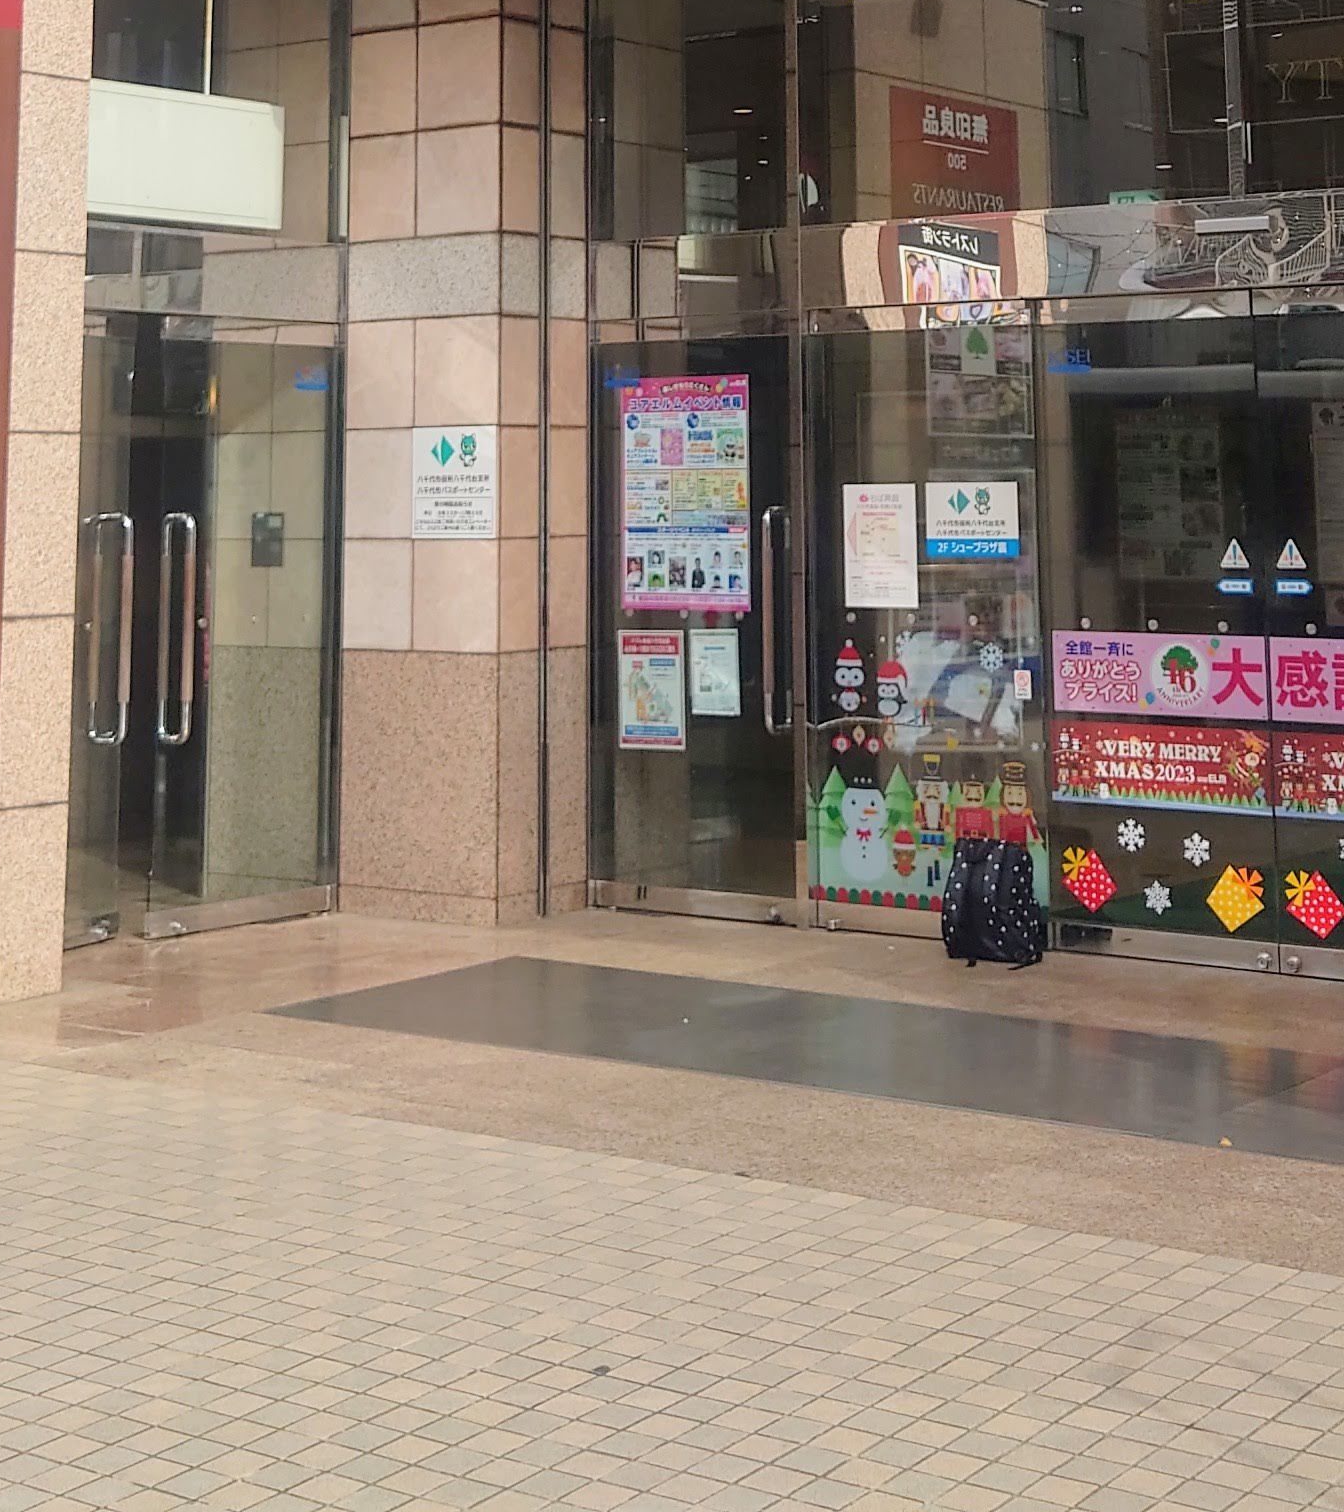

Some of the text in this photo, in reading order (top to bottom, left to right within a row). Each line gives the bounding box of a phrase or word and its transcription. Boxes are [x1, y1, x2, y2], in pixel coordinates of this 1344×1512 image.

[937, 542, 948, 553] 2F
[1065, 639, 1134, 657] 全館一斉に
[1060, 658, 1142, 682] ありがとう
[1066, 681, 1138, 703] プライス!
[1157, 686, 1207, 709] ANNIVERSARY
[1103, 740, 1222, 763] VERY MERRY
